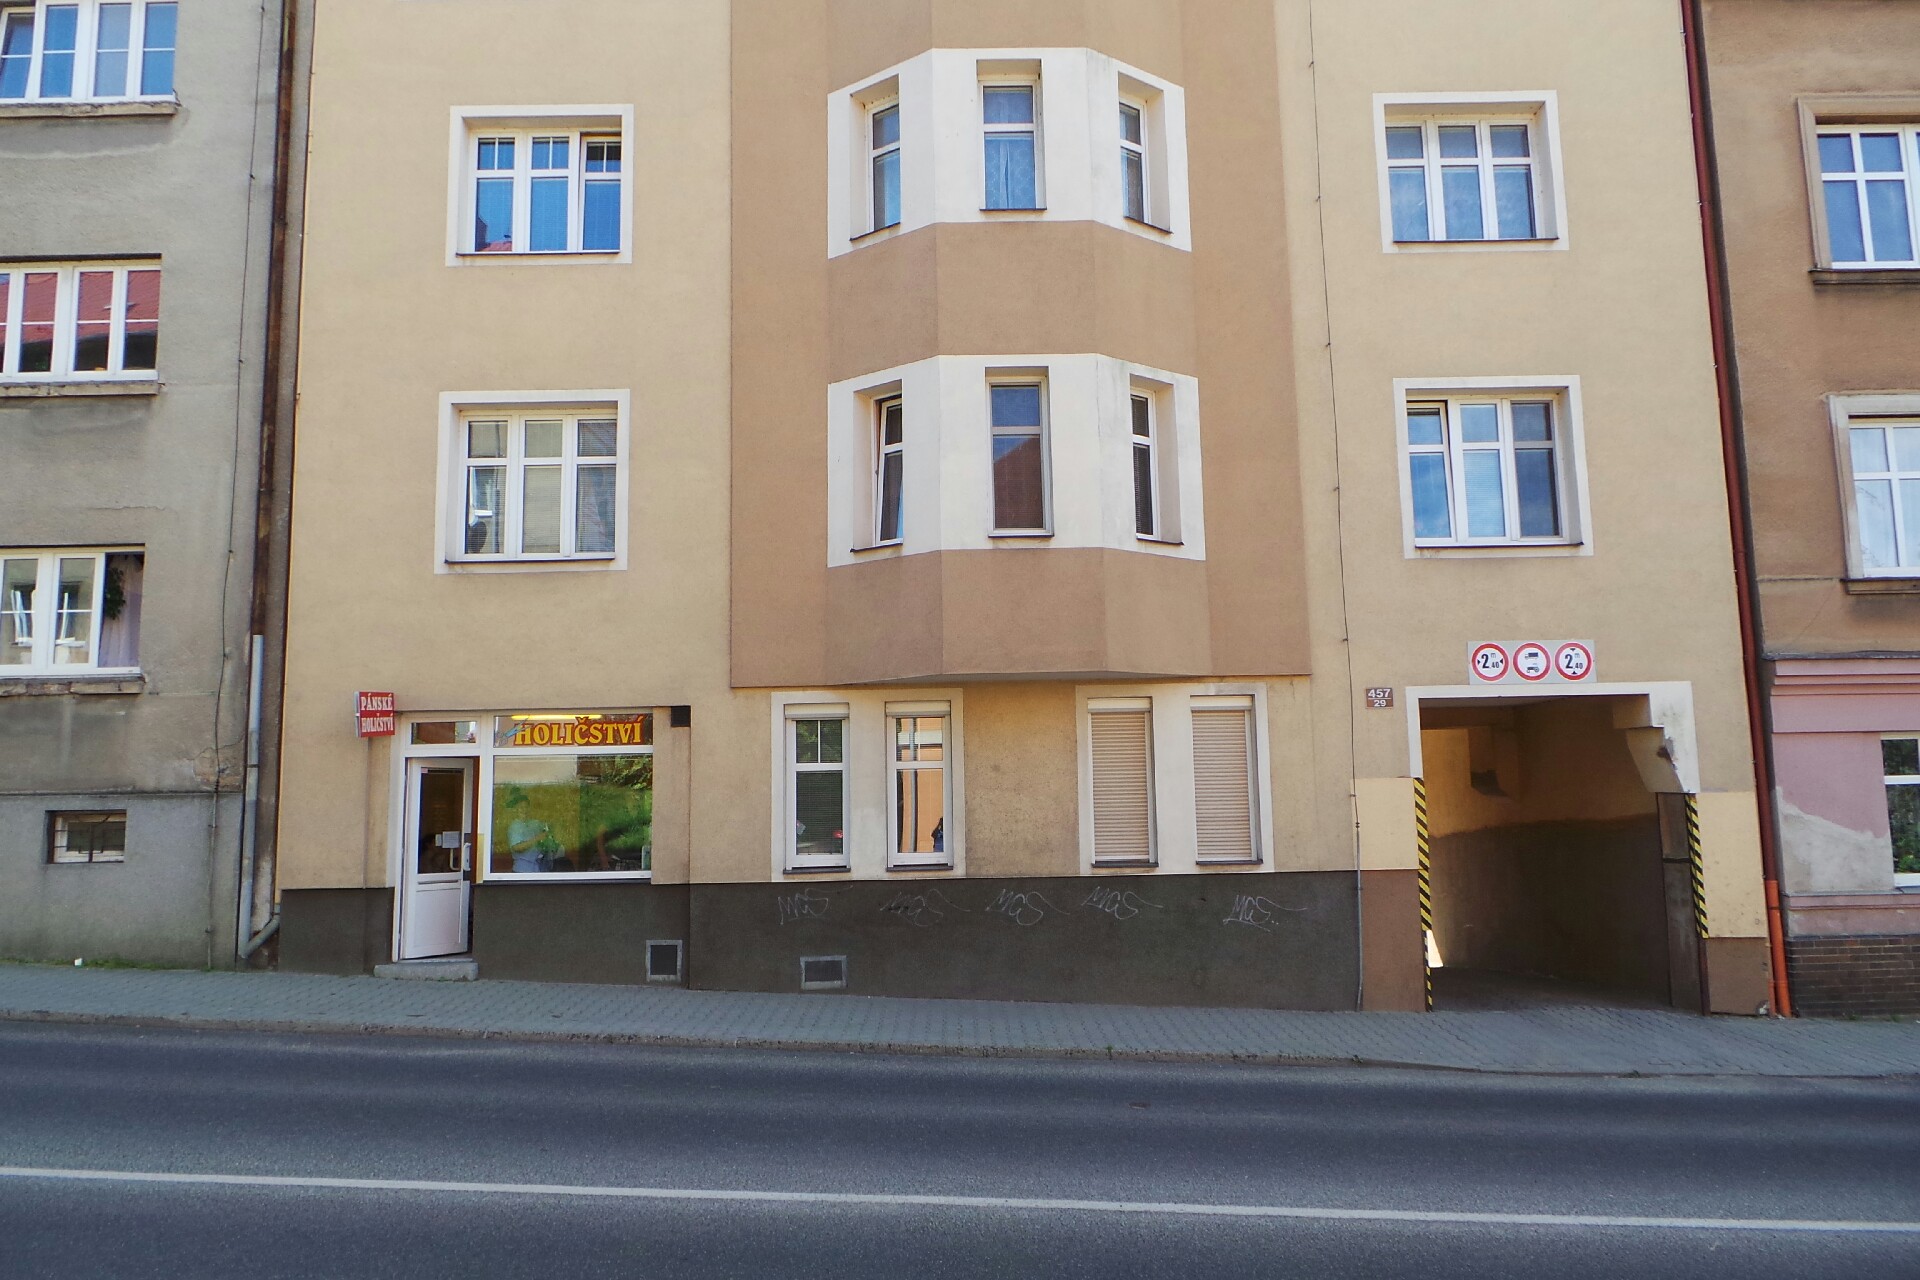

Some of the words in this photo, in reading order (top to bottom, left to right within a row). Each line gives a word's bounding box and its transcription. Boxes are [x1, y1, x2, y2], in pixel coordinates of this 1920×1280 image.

[360, 693, 393, 711] PÁNSKÉ
[1368, 688, 1391, 698] 457
[1373, 699, 1387, 707] 29
[361, 713, 394, 732] HOLIČSTVÍ
[514, 714, 645, 746] HOLIČSTVÍ
